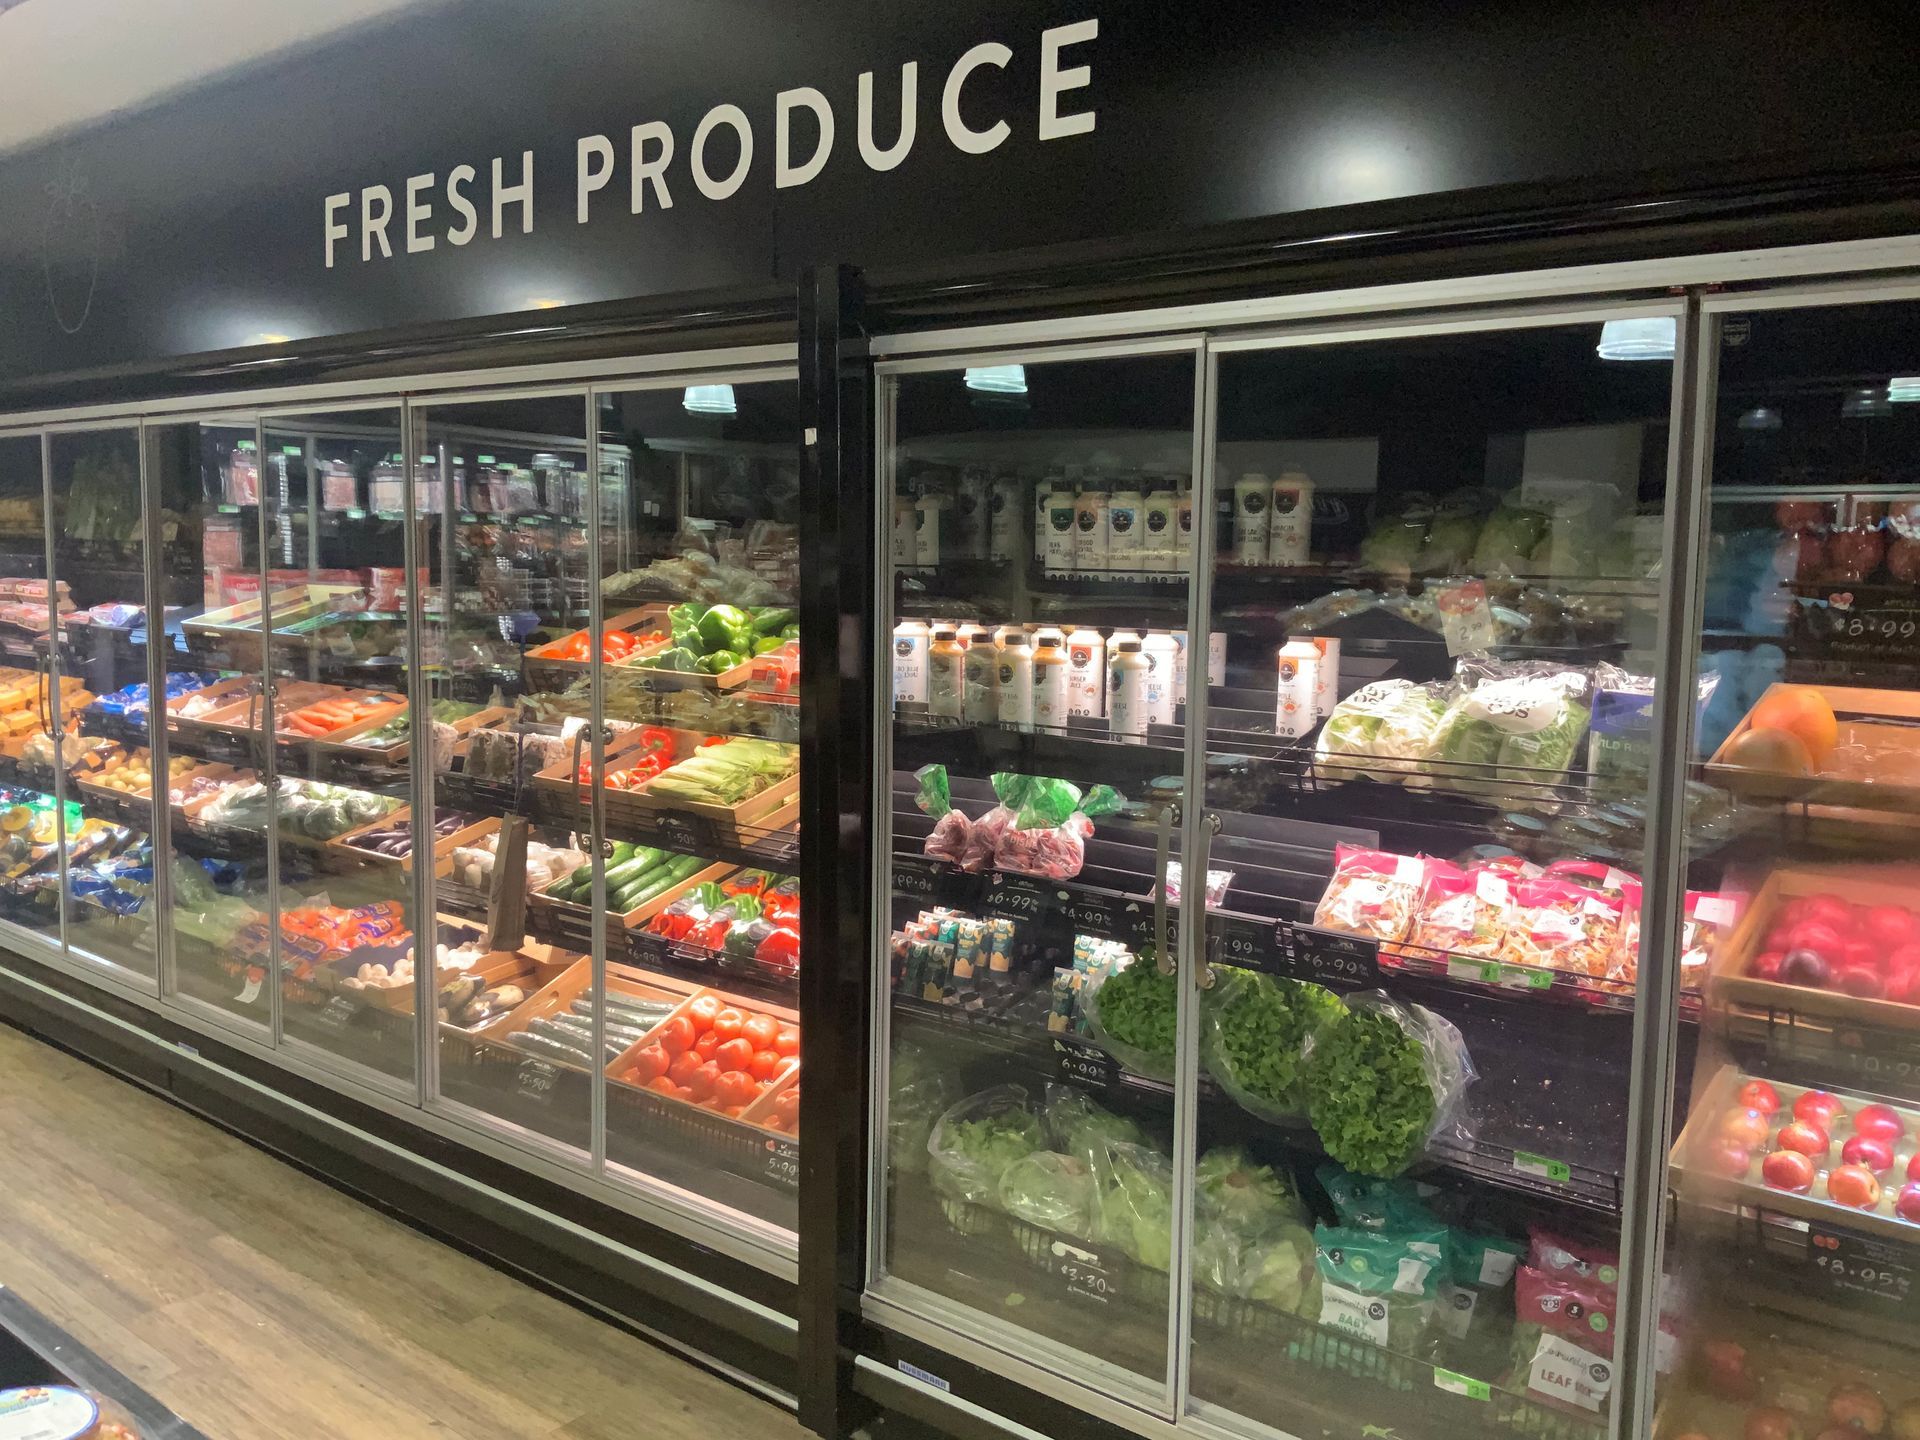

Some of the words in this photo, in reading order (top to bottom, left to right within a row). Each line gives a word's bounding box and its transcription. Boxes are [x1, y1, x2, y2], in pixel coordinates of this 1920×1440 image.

[324, 150, 534, 268] FRESH
[577, 18, 1099, 224] PRODUCE
[1834, 618, 1916, 638] $8.99
[987, 892, 1030, 909] $6.99
[1060, 905, 1102, 924] $4.99
[1303, 952, 1357, 974] $6.99
[1061, 1264, 1106, 1293] $3.30
[1339, 1313, 1369, 1330] BABY
[900, 1361, 947, 1389] HUSSMANN
[1541, 1369, 1573, 1388] LEAF
